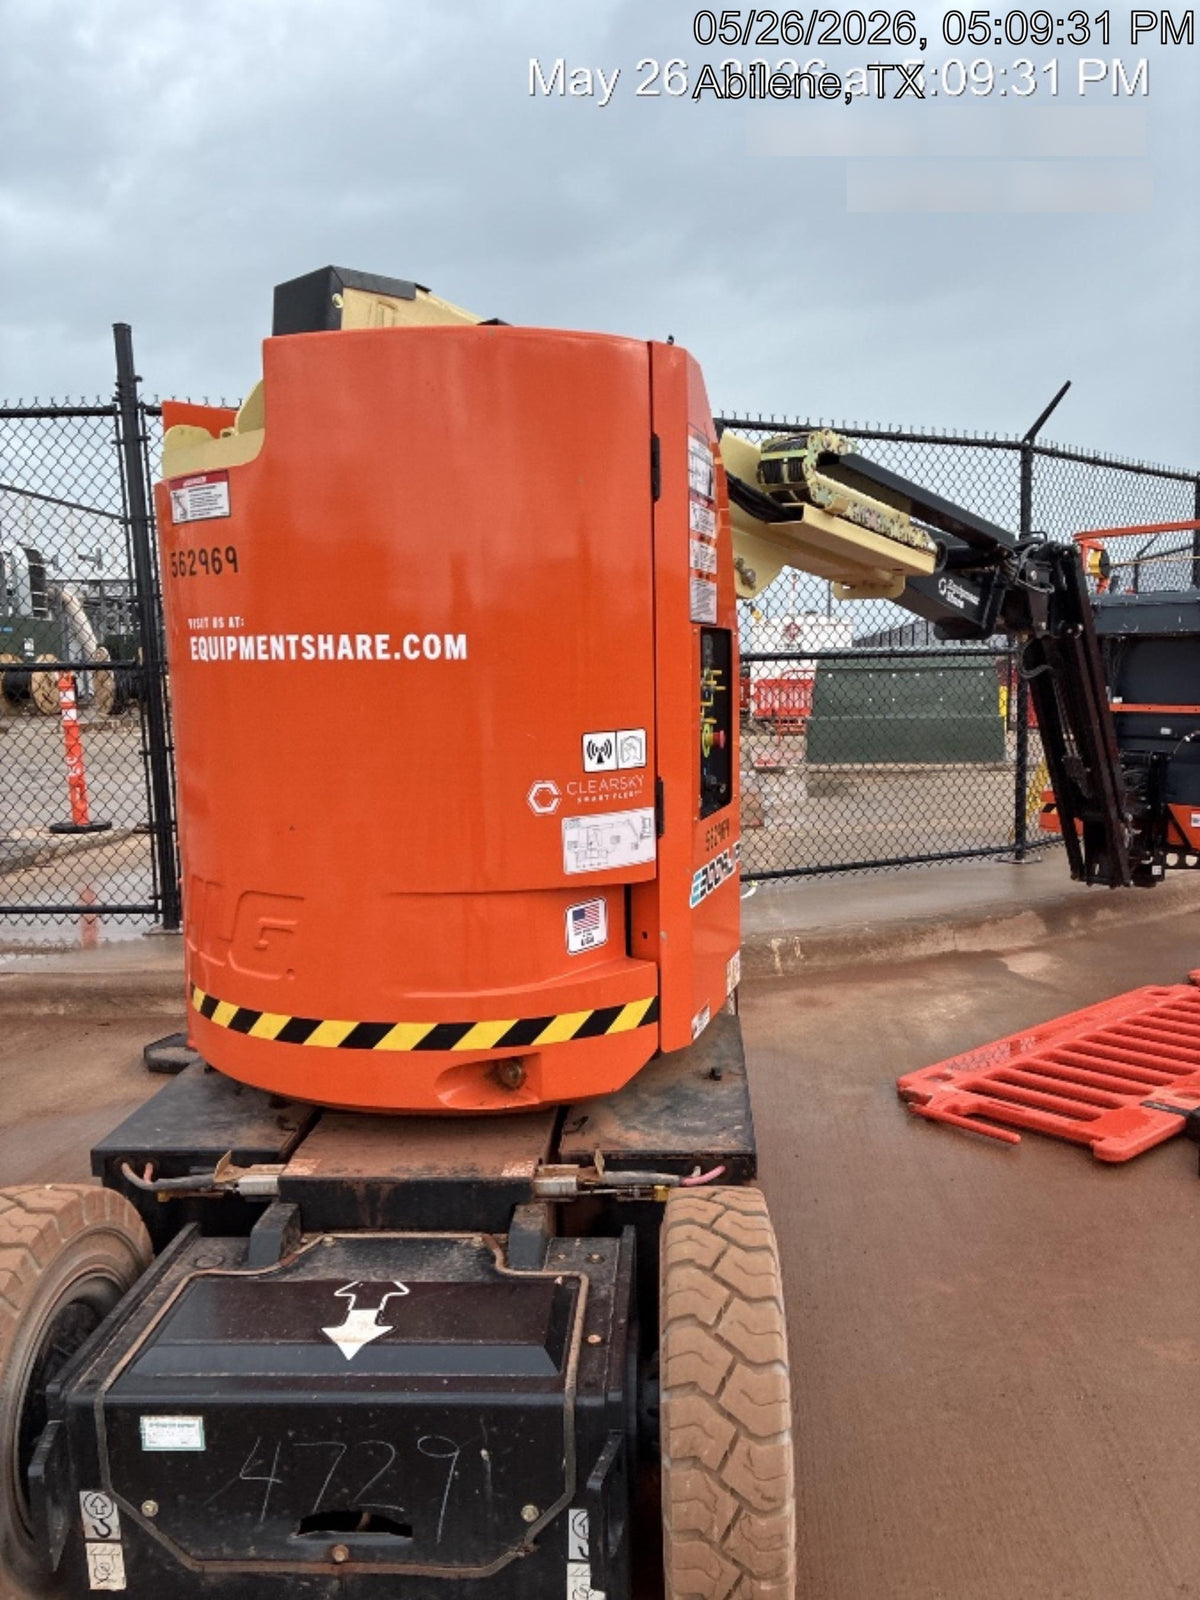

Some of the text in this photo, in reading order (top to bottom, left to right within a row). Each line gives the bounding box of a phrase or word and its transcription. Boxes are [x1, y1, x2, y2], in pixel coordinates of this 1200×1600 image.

[170, 545, 238, 578] 562969
[190, 633, 468, 661] EQUIPMENTSHARE.COM
[566, 774, 645, 796] CLEARSKY
